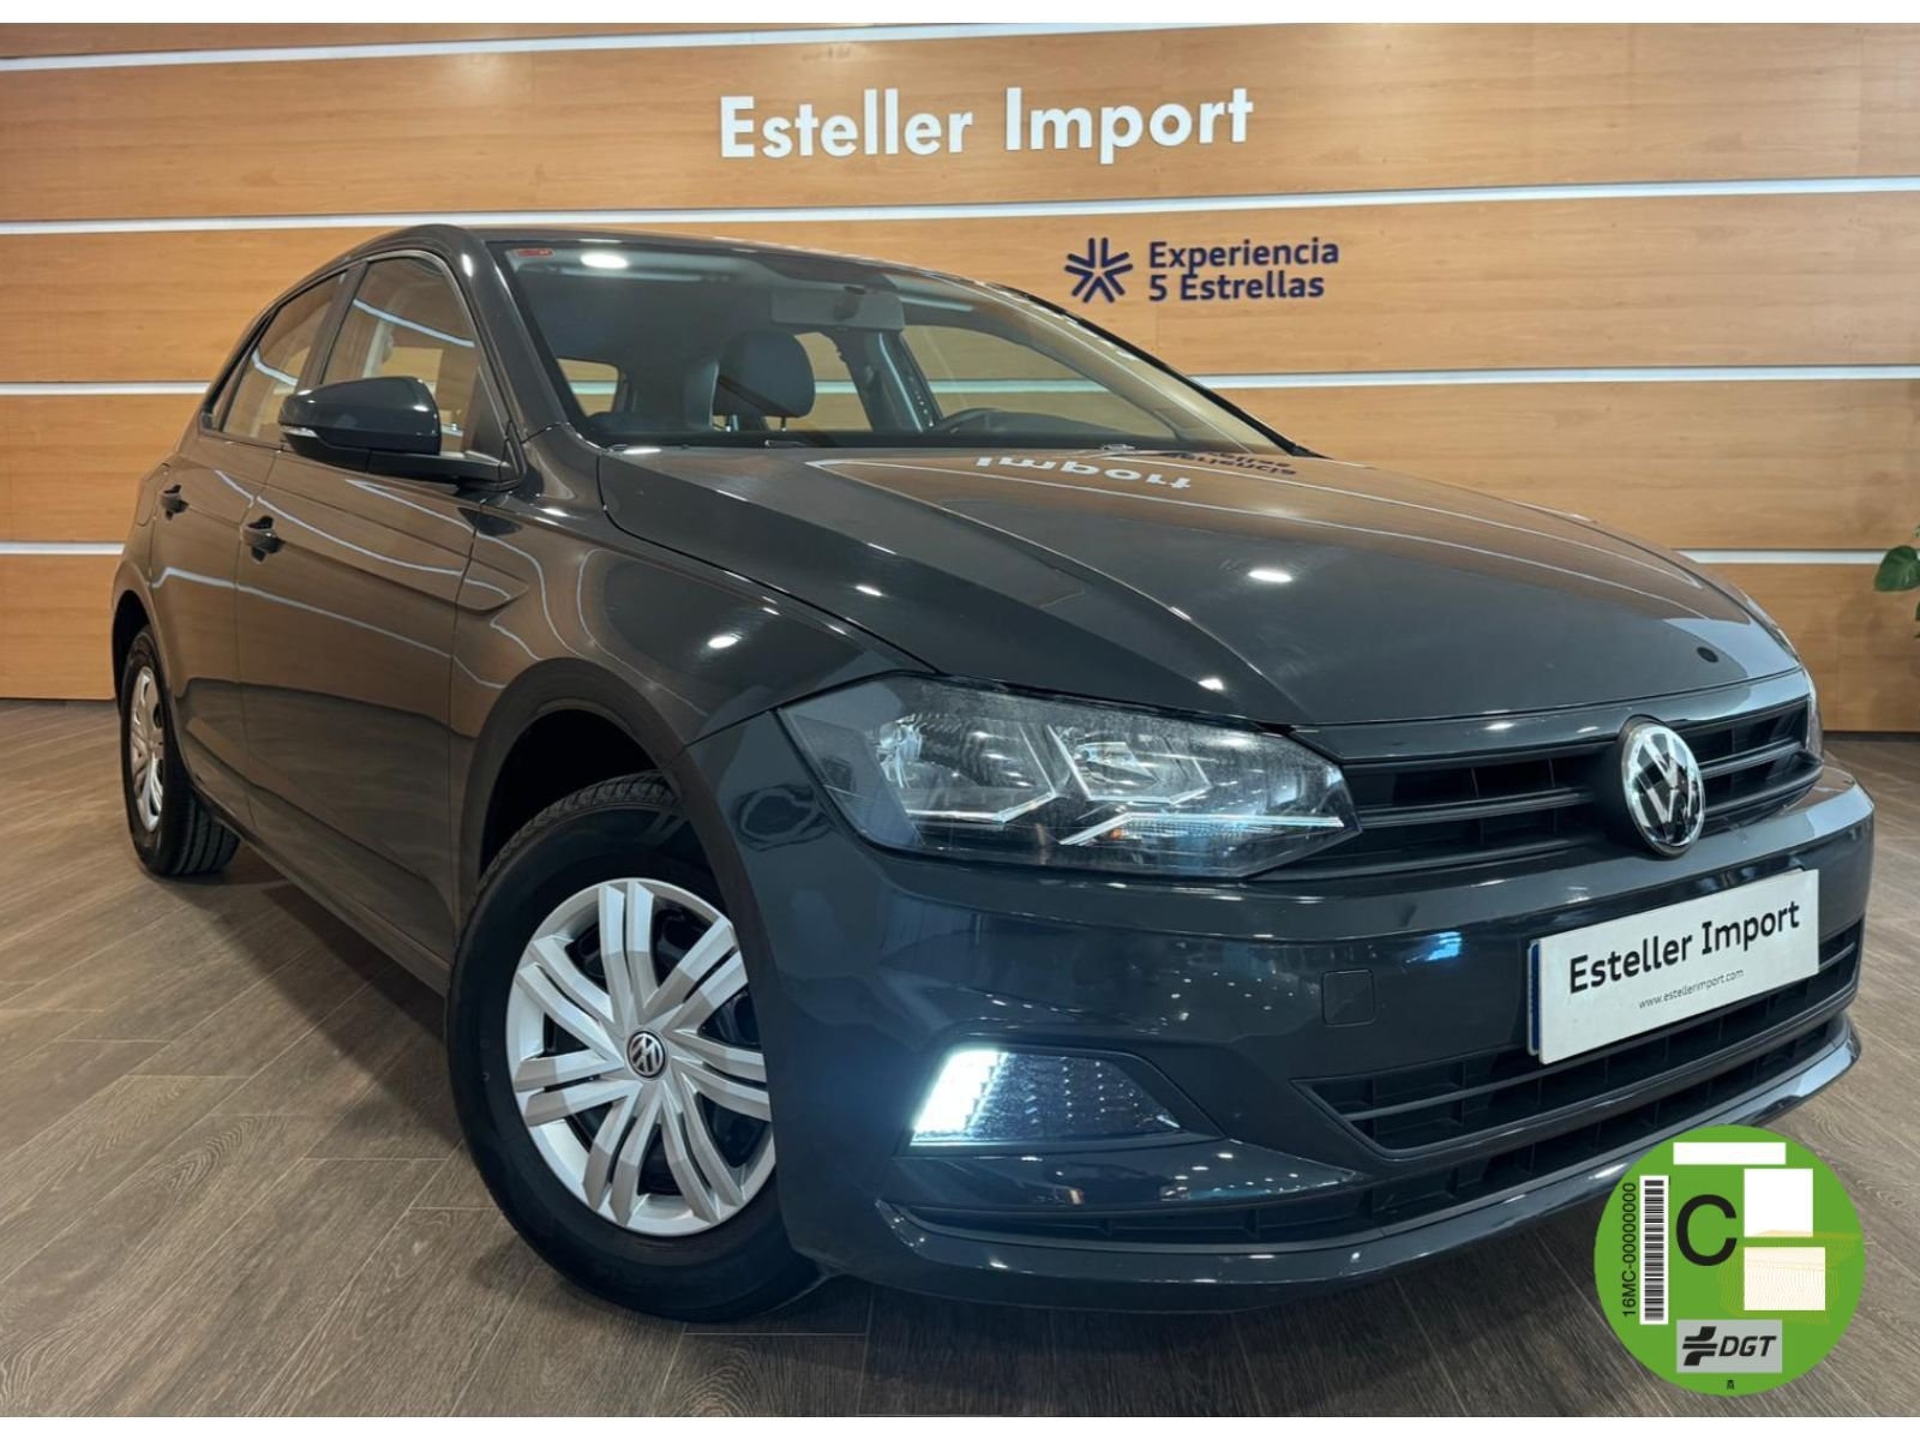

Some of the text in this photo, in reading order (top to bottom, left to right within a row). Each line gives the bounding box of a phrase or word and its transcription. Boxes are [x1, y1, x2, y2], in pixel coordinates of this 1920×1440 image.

[719, 86, 1254, 165] Esteller Import
[1149, 236, 1340, 276] Experiencia
[1149, 270, 1325, 301] 5 Estrellas
[1569, 900, 1800, 994] Esteller Import
[1638, 968, 1745, 1009] www.estellerimport.com
